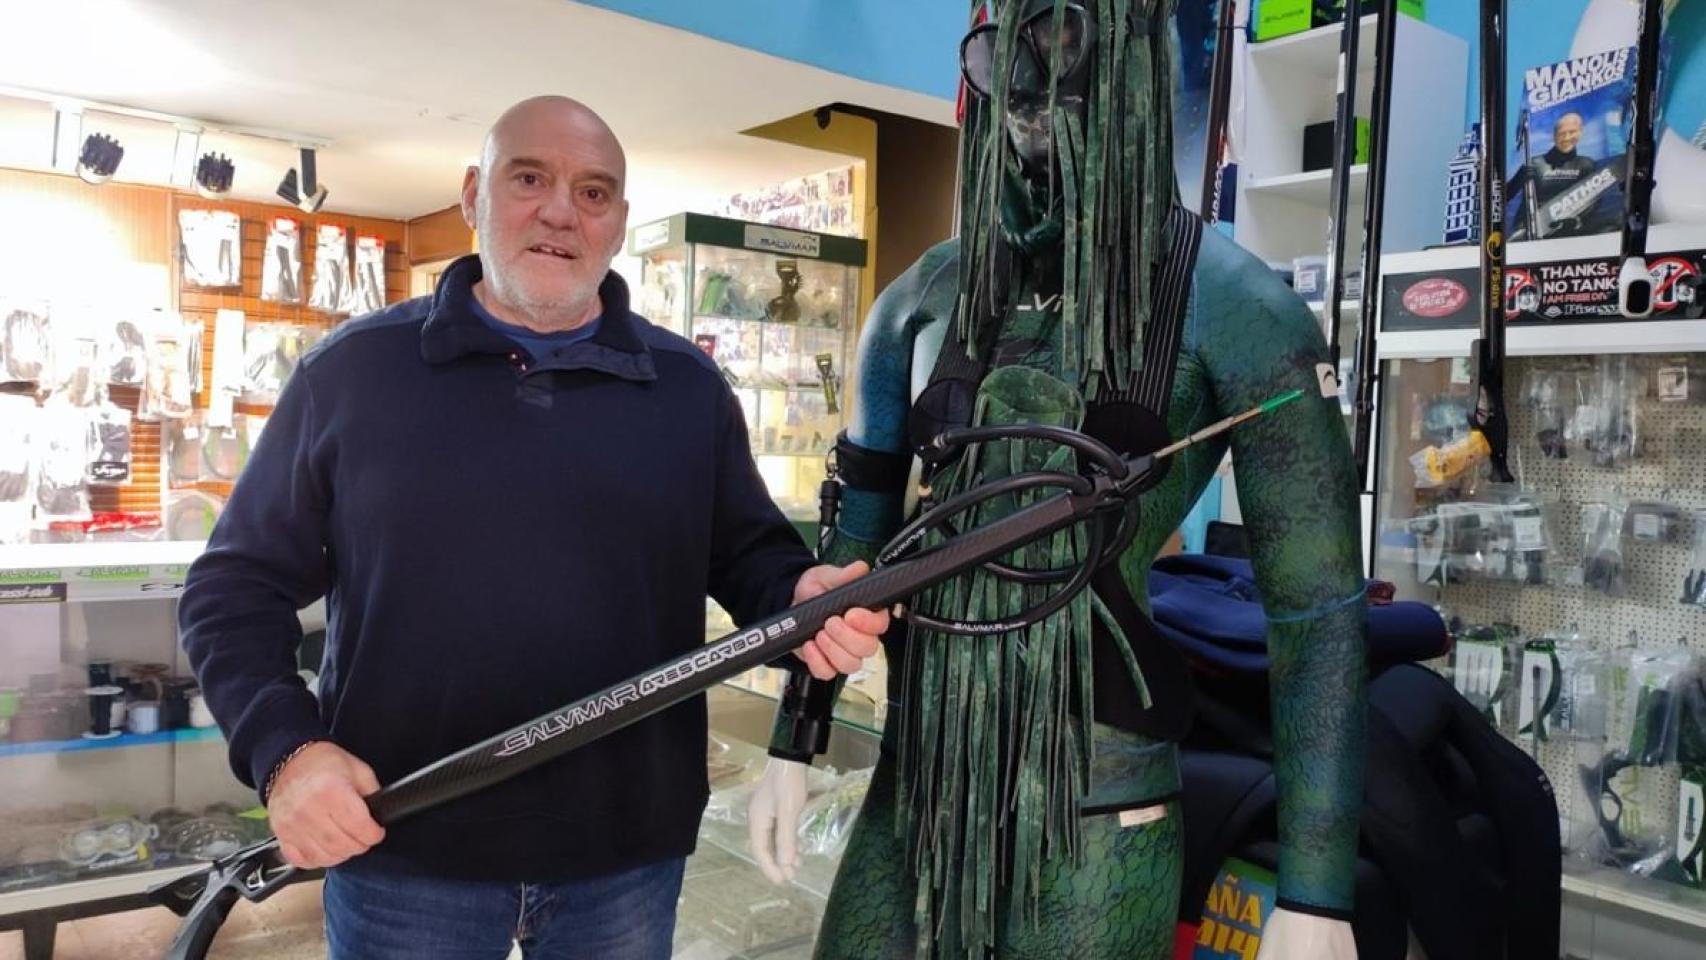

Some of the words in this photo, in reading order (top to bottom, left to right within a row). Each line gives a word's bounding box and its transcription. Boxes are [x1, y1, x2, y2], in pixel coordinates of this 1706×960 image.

[1525, 48, 1629, 91] MANOLIS
[1543, 281, 1568, 294] NO
[1571, 276, 1620, 293] TANK
[691, 628, 766, 675] CARBO
